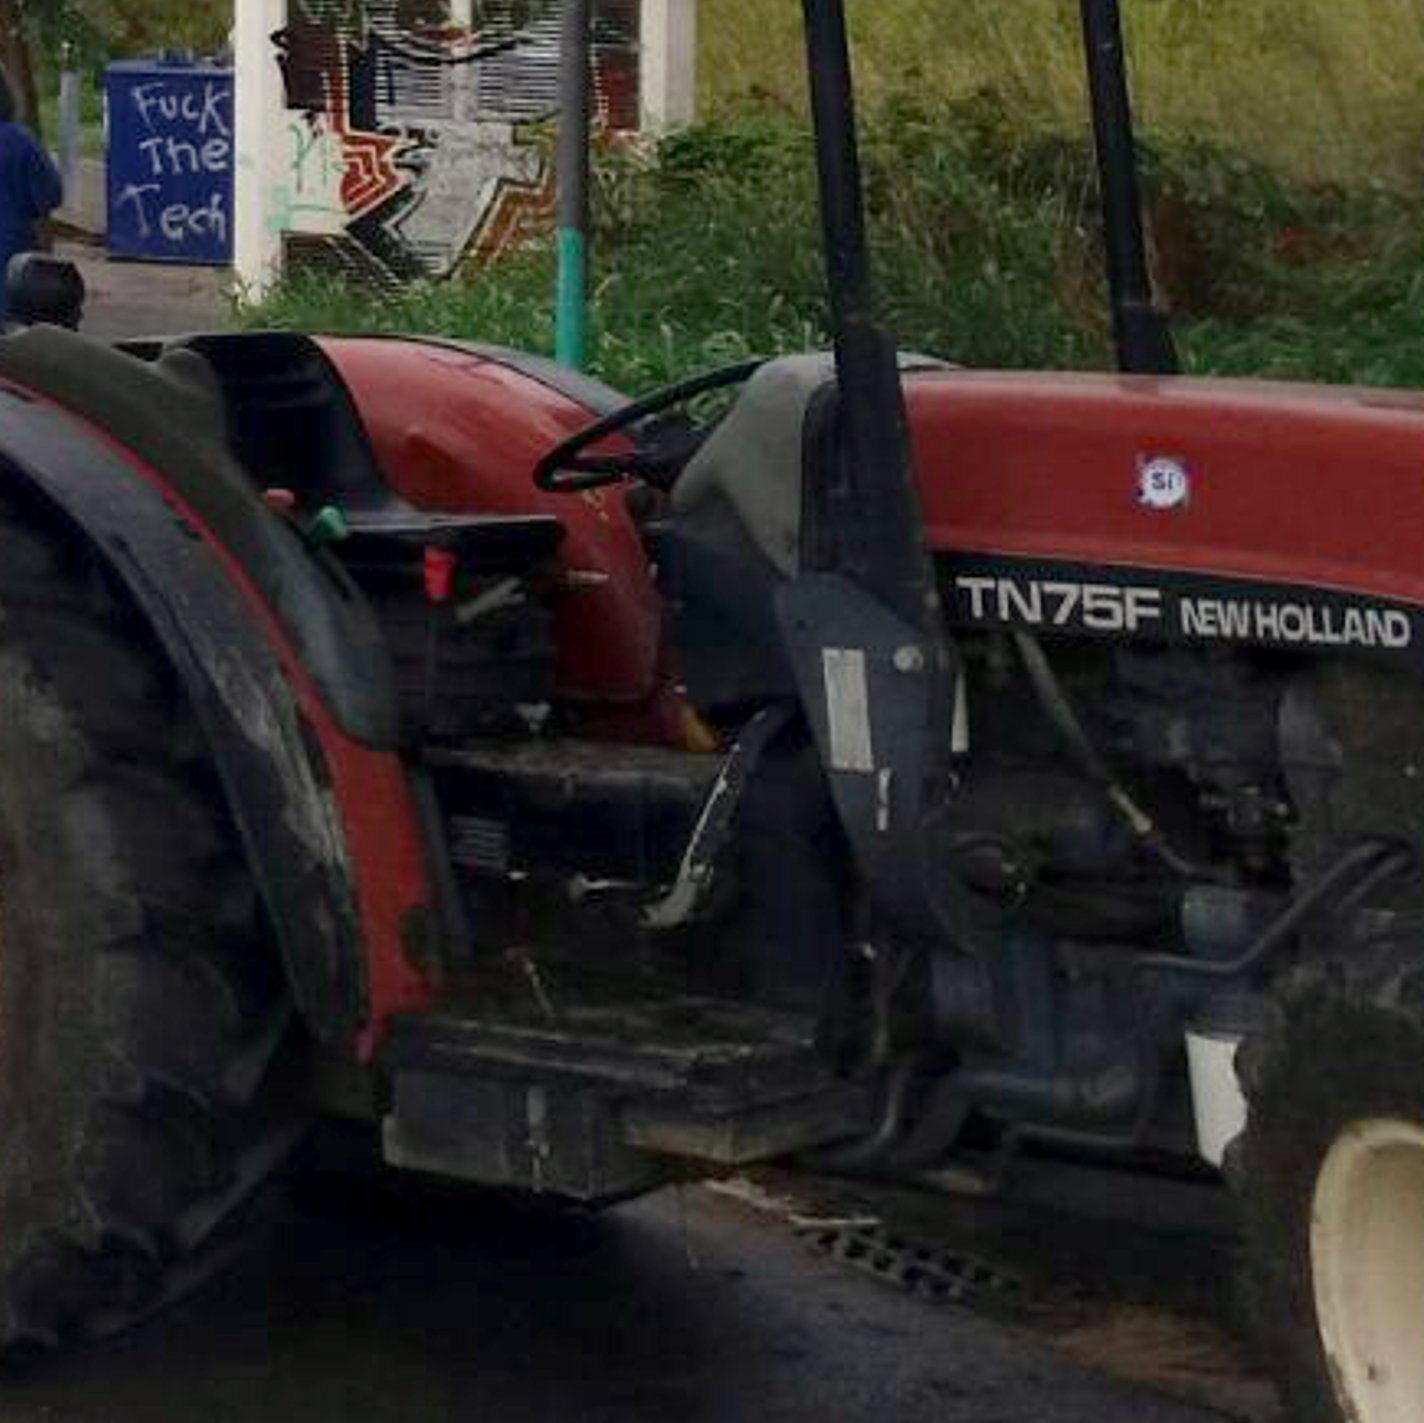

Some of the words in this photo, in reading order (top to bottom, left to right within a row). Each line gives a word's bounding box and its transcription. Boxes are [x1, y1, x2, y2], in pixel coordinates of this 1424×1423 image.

[138, 137, 230, 175] The
[956, 576, 1161, 631] TN75F
[1180, 599, 1249, 638] NEW
[1255, 602, 1410, 648] HOLLAND
